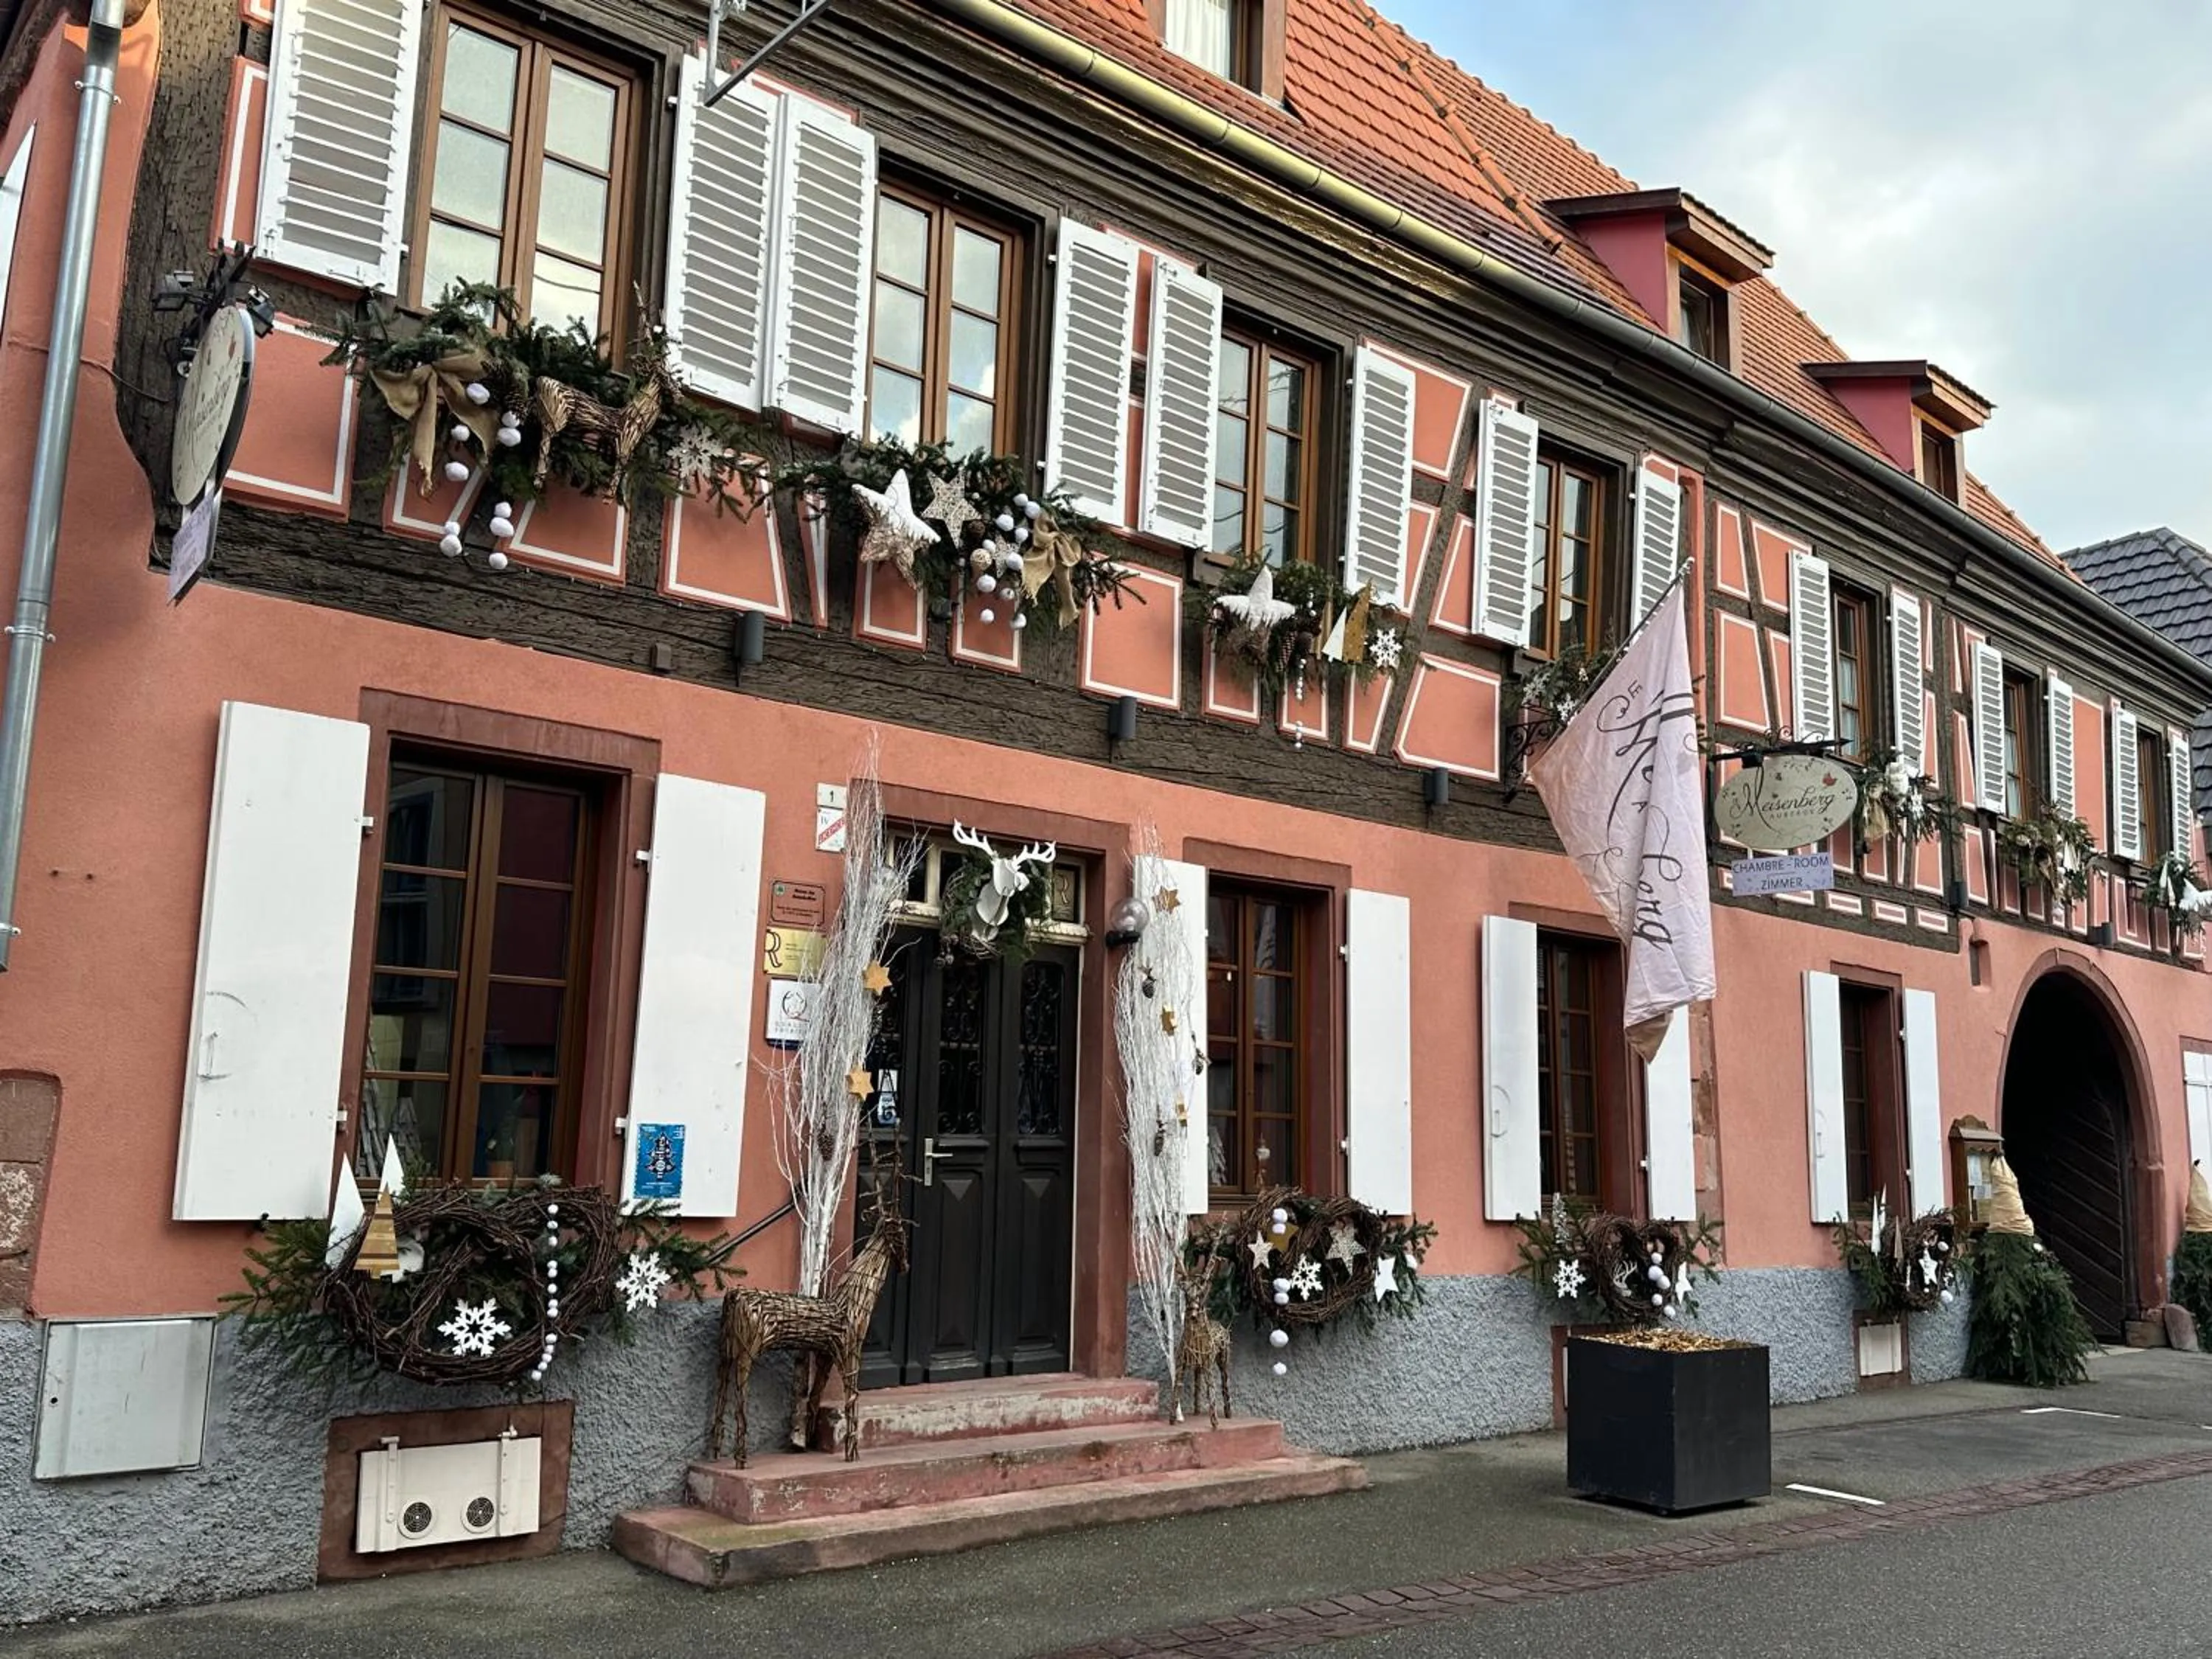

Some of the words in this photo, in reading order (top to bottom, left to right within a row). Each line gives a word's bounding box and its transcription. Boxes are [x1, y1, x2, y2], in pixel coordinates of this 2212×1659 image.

[1627, 679, 1643, 699] LE
[830, 790, 834, 802] 1
[1730, 766, 1835, 833] Meisenberg
[1733, 859, 1784, 874] CHAMBRE
[1794, 856, 1829, 869] ROOM
[1761, 877, 1803, 890] ZIMMER
